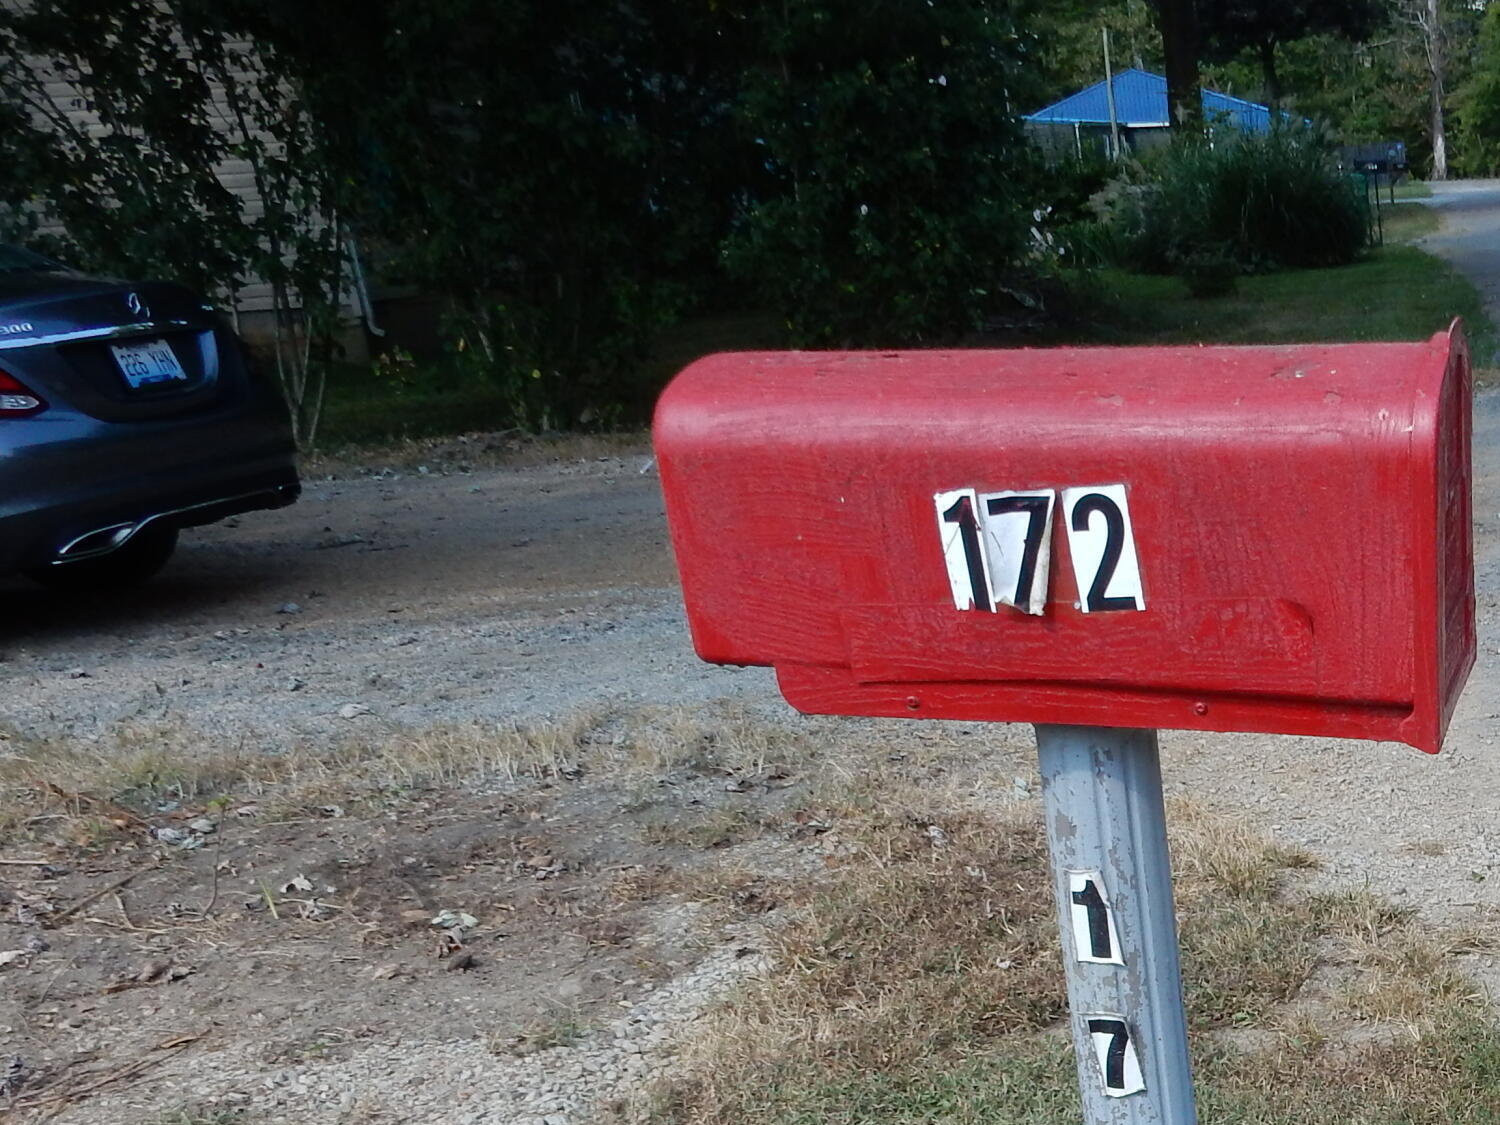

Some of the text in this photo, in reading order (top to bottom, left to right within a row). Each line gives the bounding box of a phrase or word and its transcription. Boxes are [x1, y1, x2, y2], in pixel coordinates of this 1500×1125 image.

[121, 348, 179, 376] 226 YHN
[942, 492, 1138, 611] 172
